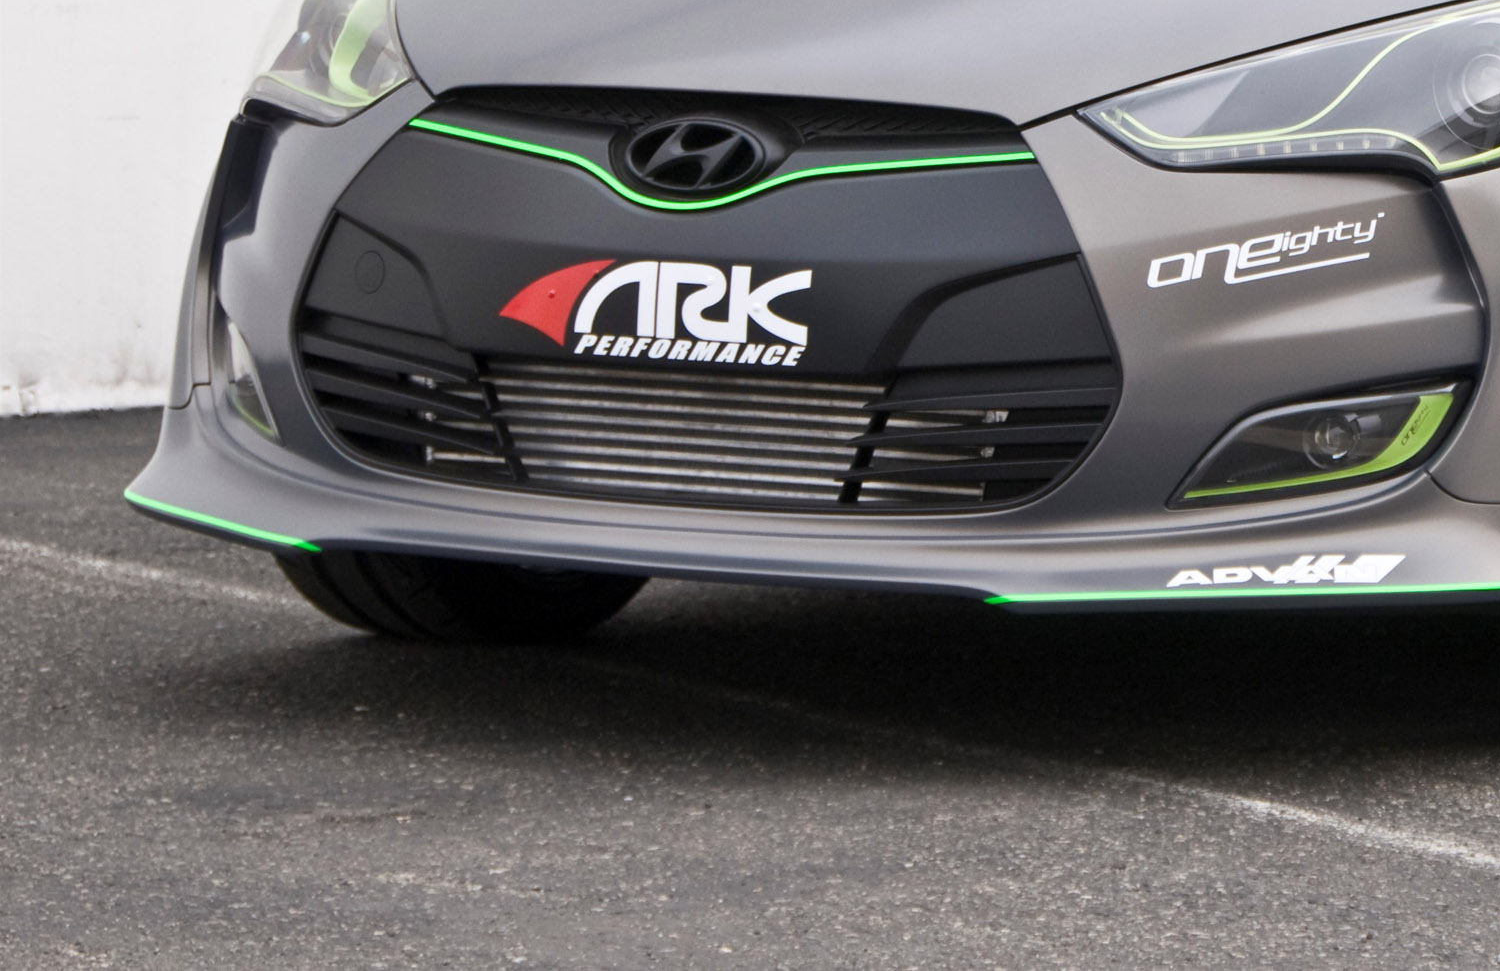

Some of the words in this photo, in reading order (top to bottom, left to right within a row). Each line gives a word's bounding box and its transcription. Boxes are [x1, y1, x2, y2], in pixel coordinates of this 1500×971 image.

[573, 261, 813, 347] ARK
[573, 334, 807, 367] PERFORMANCE
[1166, 553, 1407, 588] ADVAN
